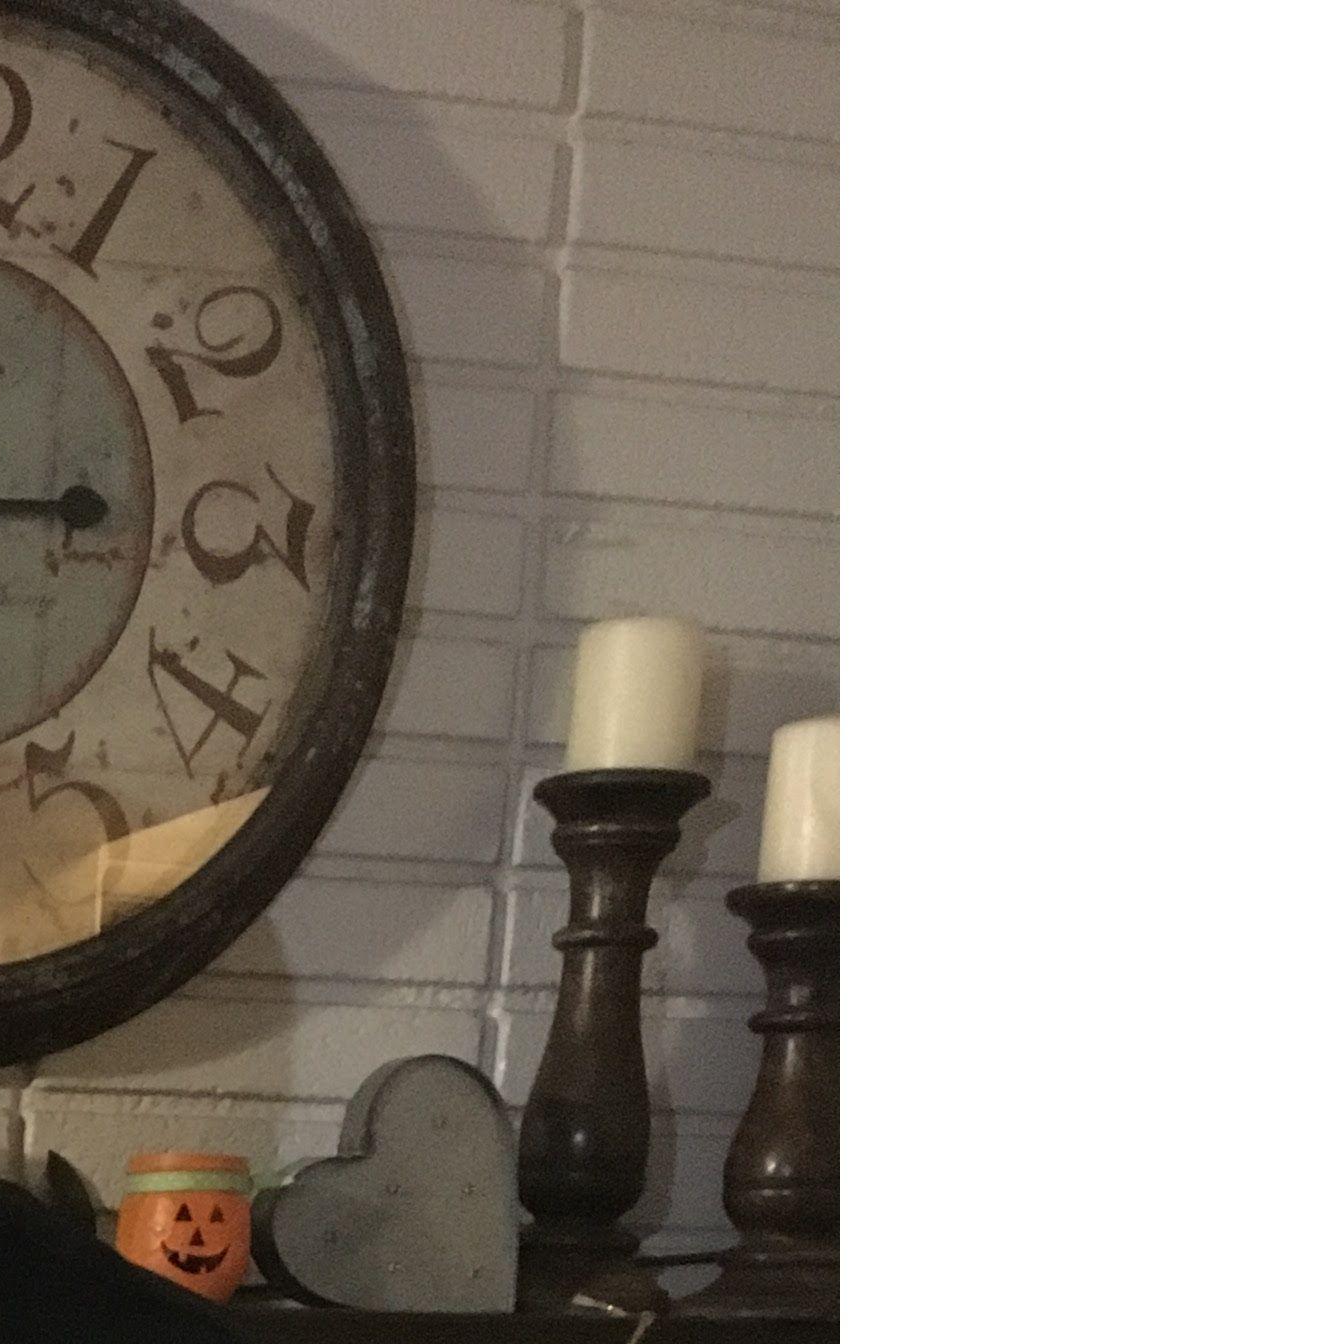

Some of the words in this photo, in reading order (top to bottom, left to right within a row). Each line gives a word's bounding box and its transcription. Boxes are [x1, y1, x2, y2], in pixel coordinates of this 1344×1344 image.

[50, 138, 158, 281] 1
[144, 286, 283, 424] 2
[181, 462, 316, 593] 3
[147, 626, 272, 780] 4
